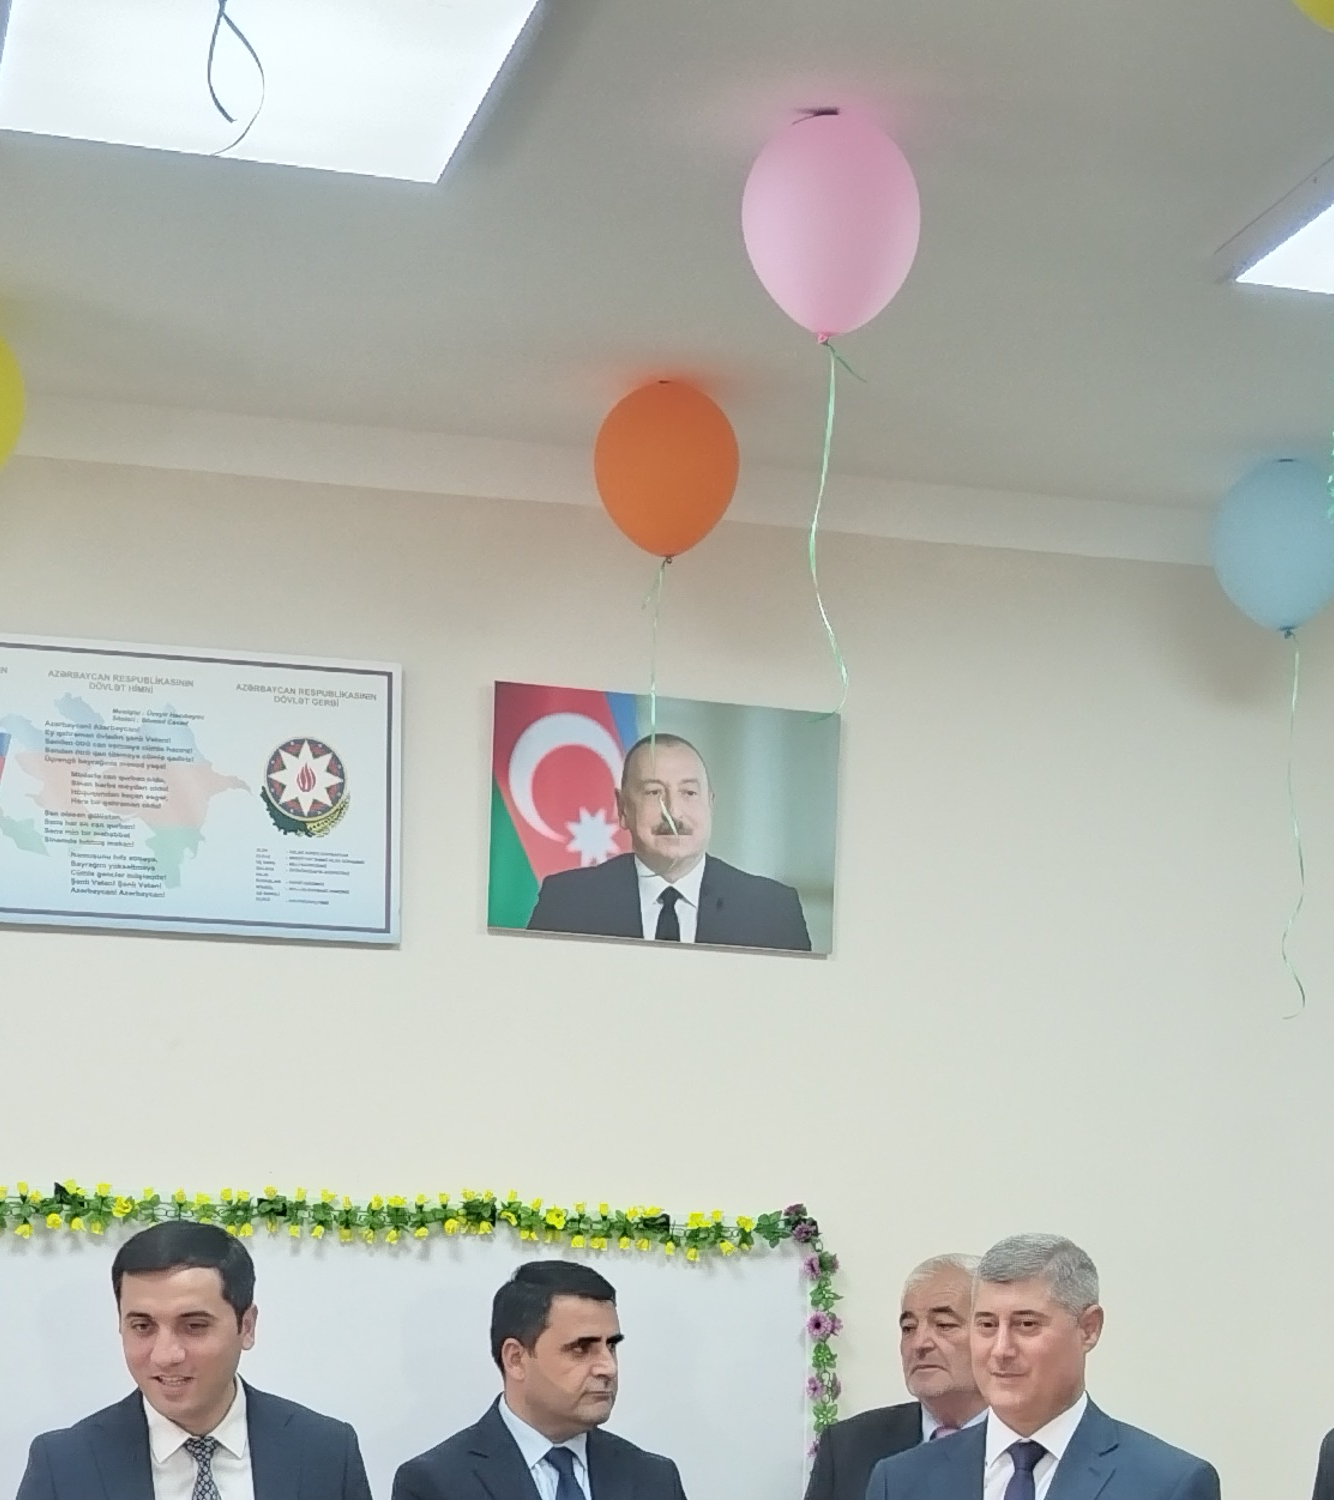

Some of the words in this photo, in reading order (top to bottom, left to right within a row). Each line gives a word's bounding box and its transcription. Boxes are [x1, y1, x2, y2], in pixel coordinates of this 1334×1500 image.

[48, 669, 110, 682] AZƏRBAYCAN
[89, 682, 126, 692] DÖVLƏT
[128, 684, 154, 694] HİMNİ
[236, 683, 296, 695] AZƏRBAYCAN
[273, 695, 310, 705] DÖVLƏT
[312, 698, 340, 708] GERBİ
